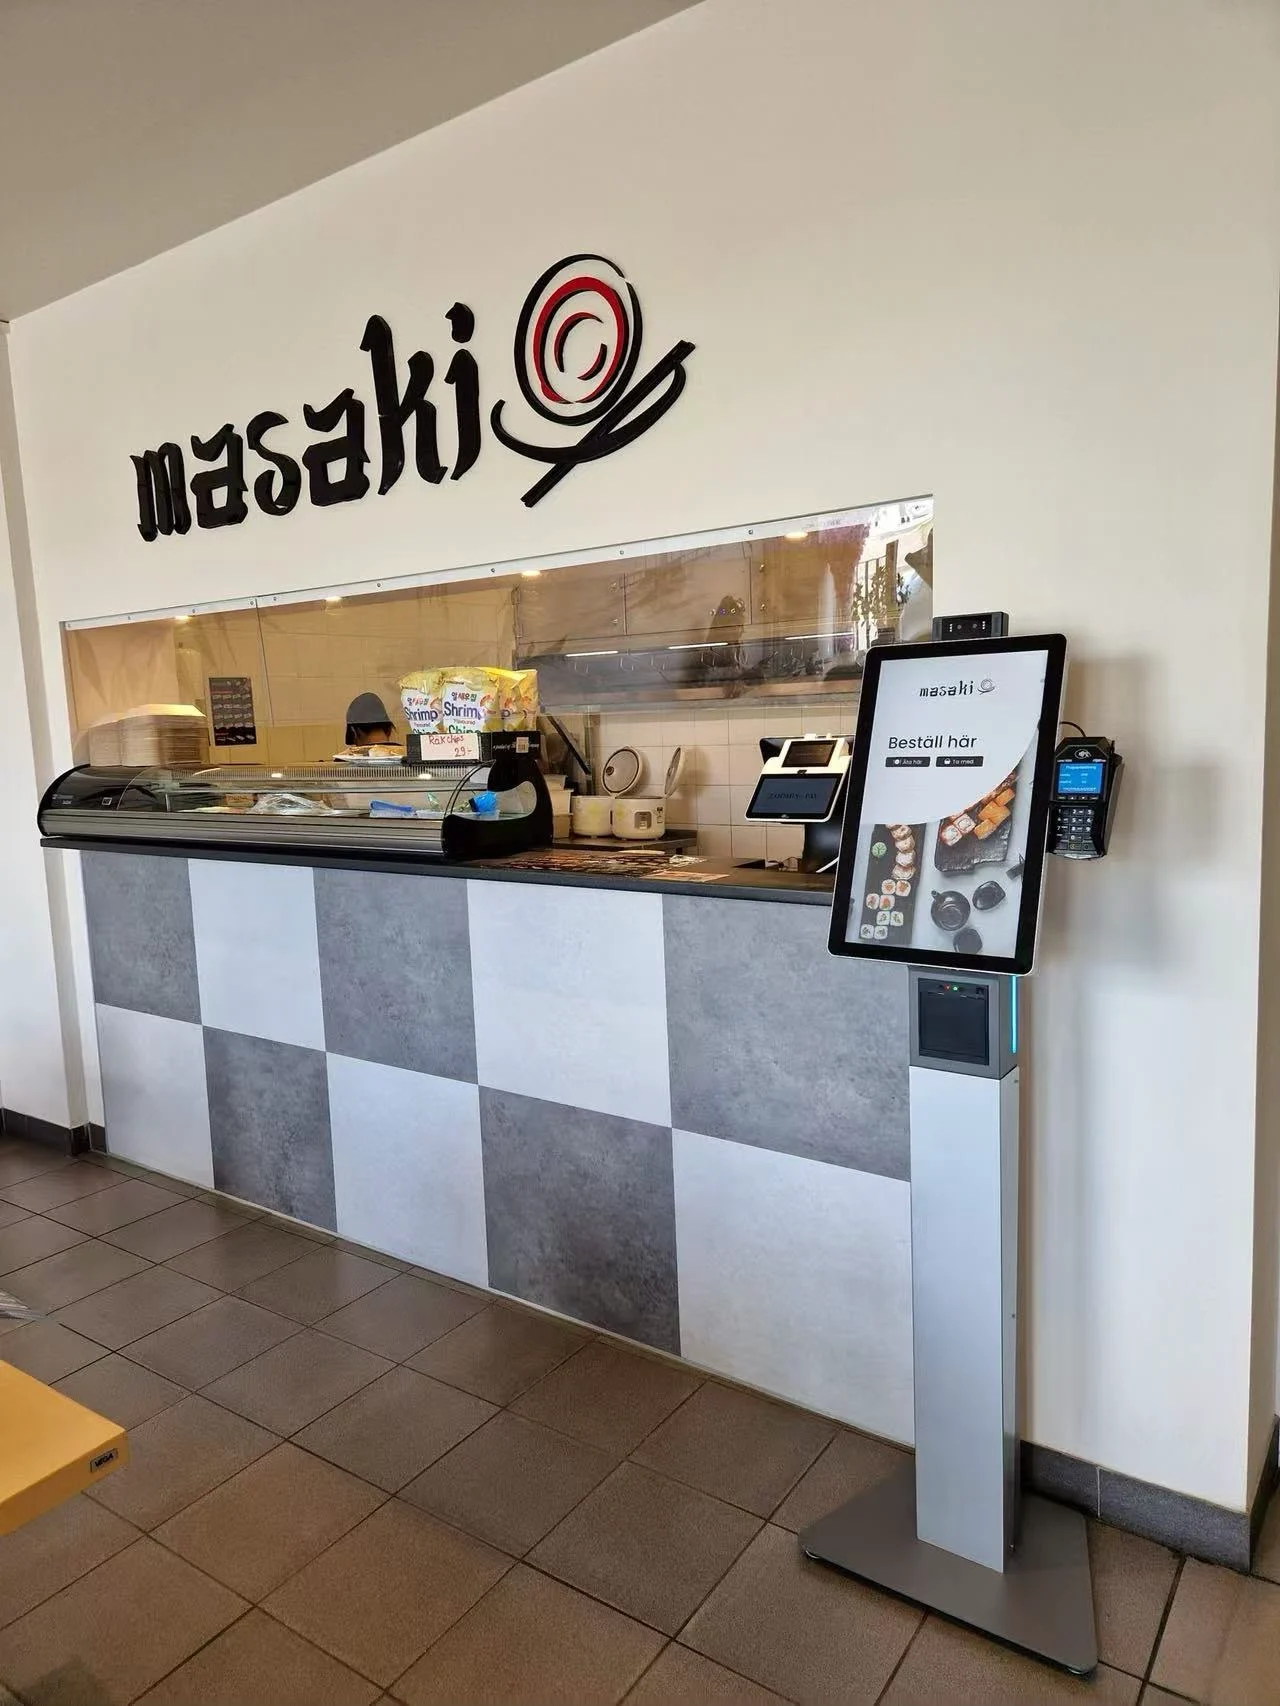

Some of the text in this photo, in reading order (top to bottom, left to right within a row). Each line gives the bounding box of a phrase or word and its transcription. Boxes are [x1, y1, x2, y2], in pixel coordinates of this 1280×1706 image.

[130, 302, 482, 542] masaki
[919, 680, 974, 697] masaki
[403, 706, 438, 722] Shrimp
[888, 735, 977, 749] Beställ här
